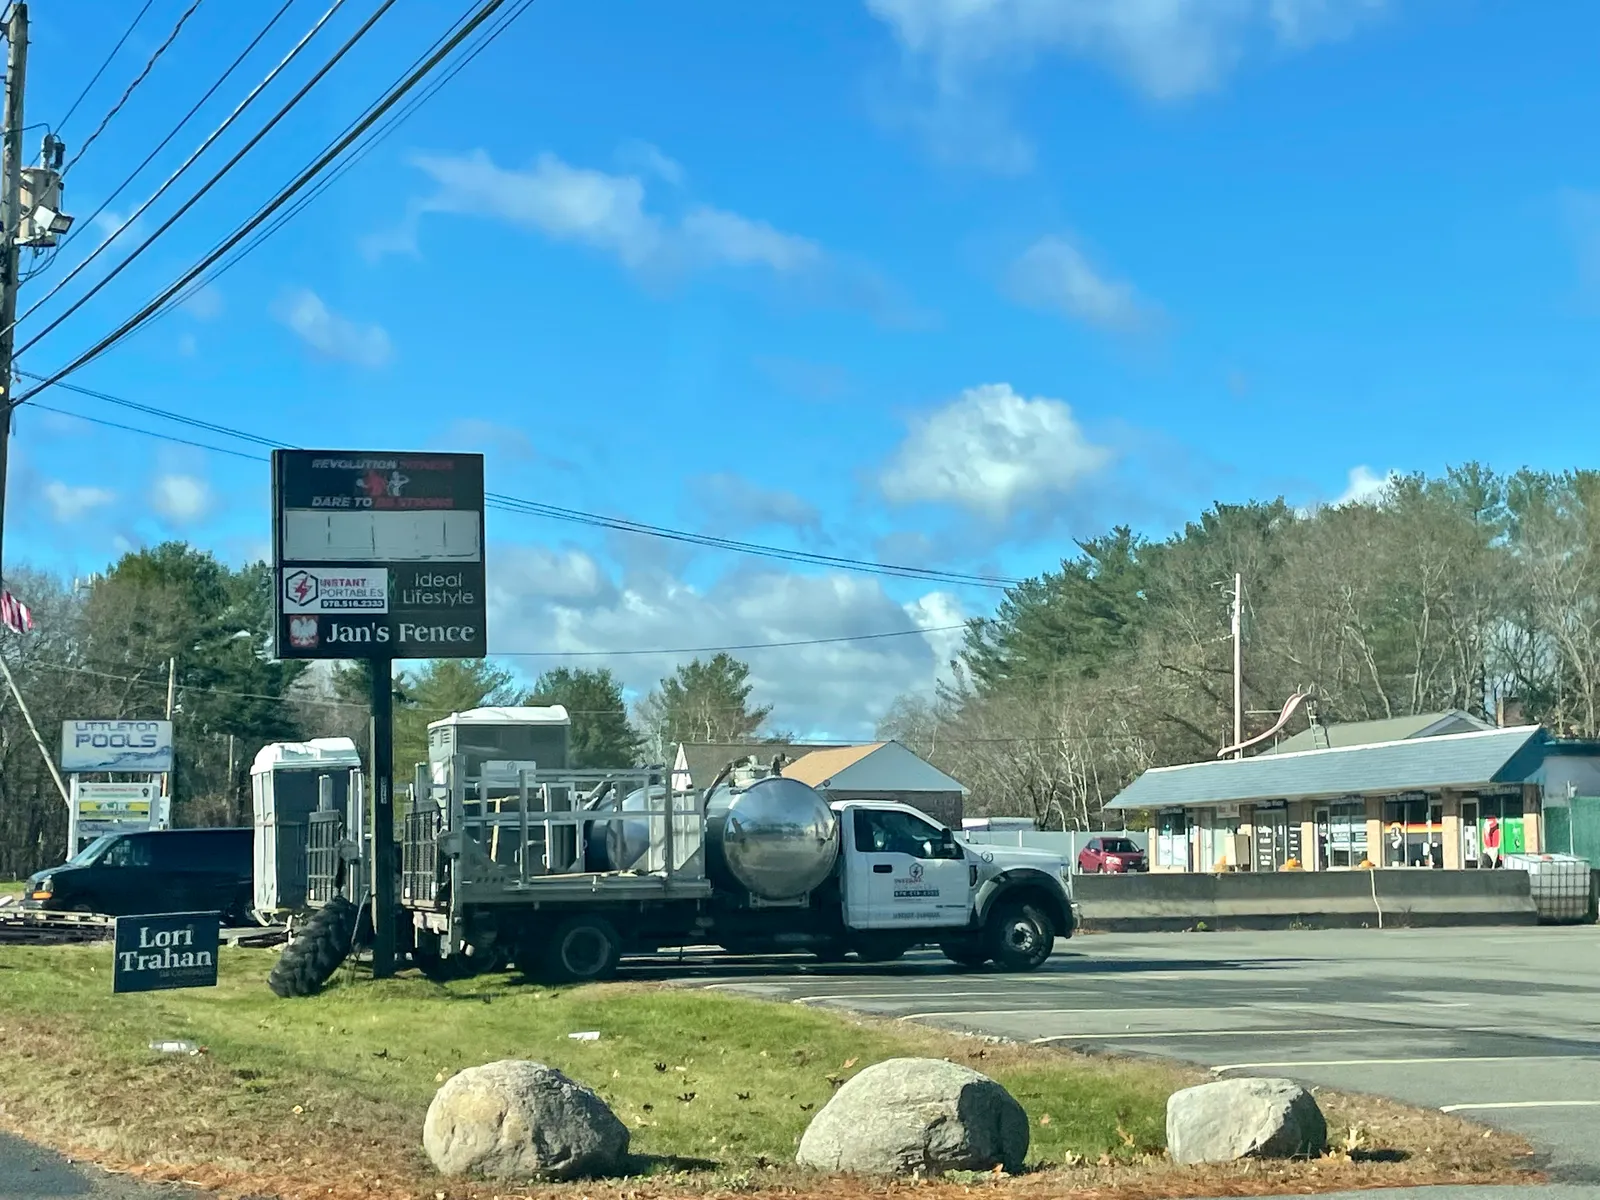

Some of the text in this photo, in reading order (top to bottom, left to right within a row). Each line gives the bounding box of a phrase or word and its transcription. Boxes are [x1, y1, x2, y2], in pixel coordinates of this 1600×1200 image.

[311, 458, 397, 469] REVOLUTION
[311, 496, 350, 507] DARE
[354, 497, 373, 507] TO
[319, 578, 367, 588] INSTANT
[319, 588, 385, 598] PORTABLES
[403, 588, 475, 608] Lifestyle
[326, 622, 476, 643] Jan's Fence
[75, 721, 159, 732] LITTLETON
[75, 733, 157, 748] POOLS
[139, 924, 193, 948] Lori
[119, 947, 213, 972] Trahan
